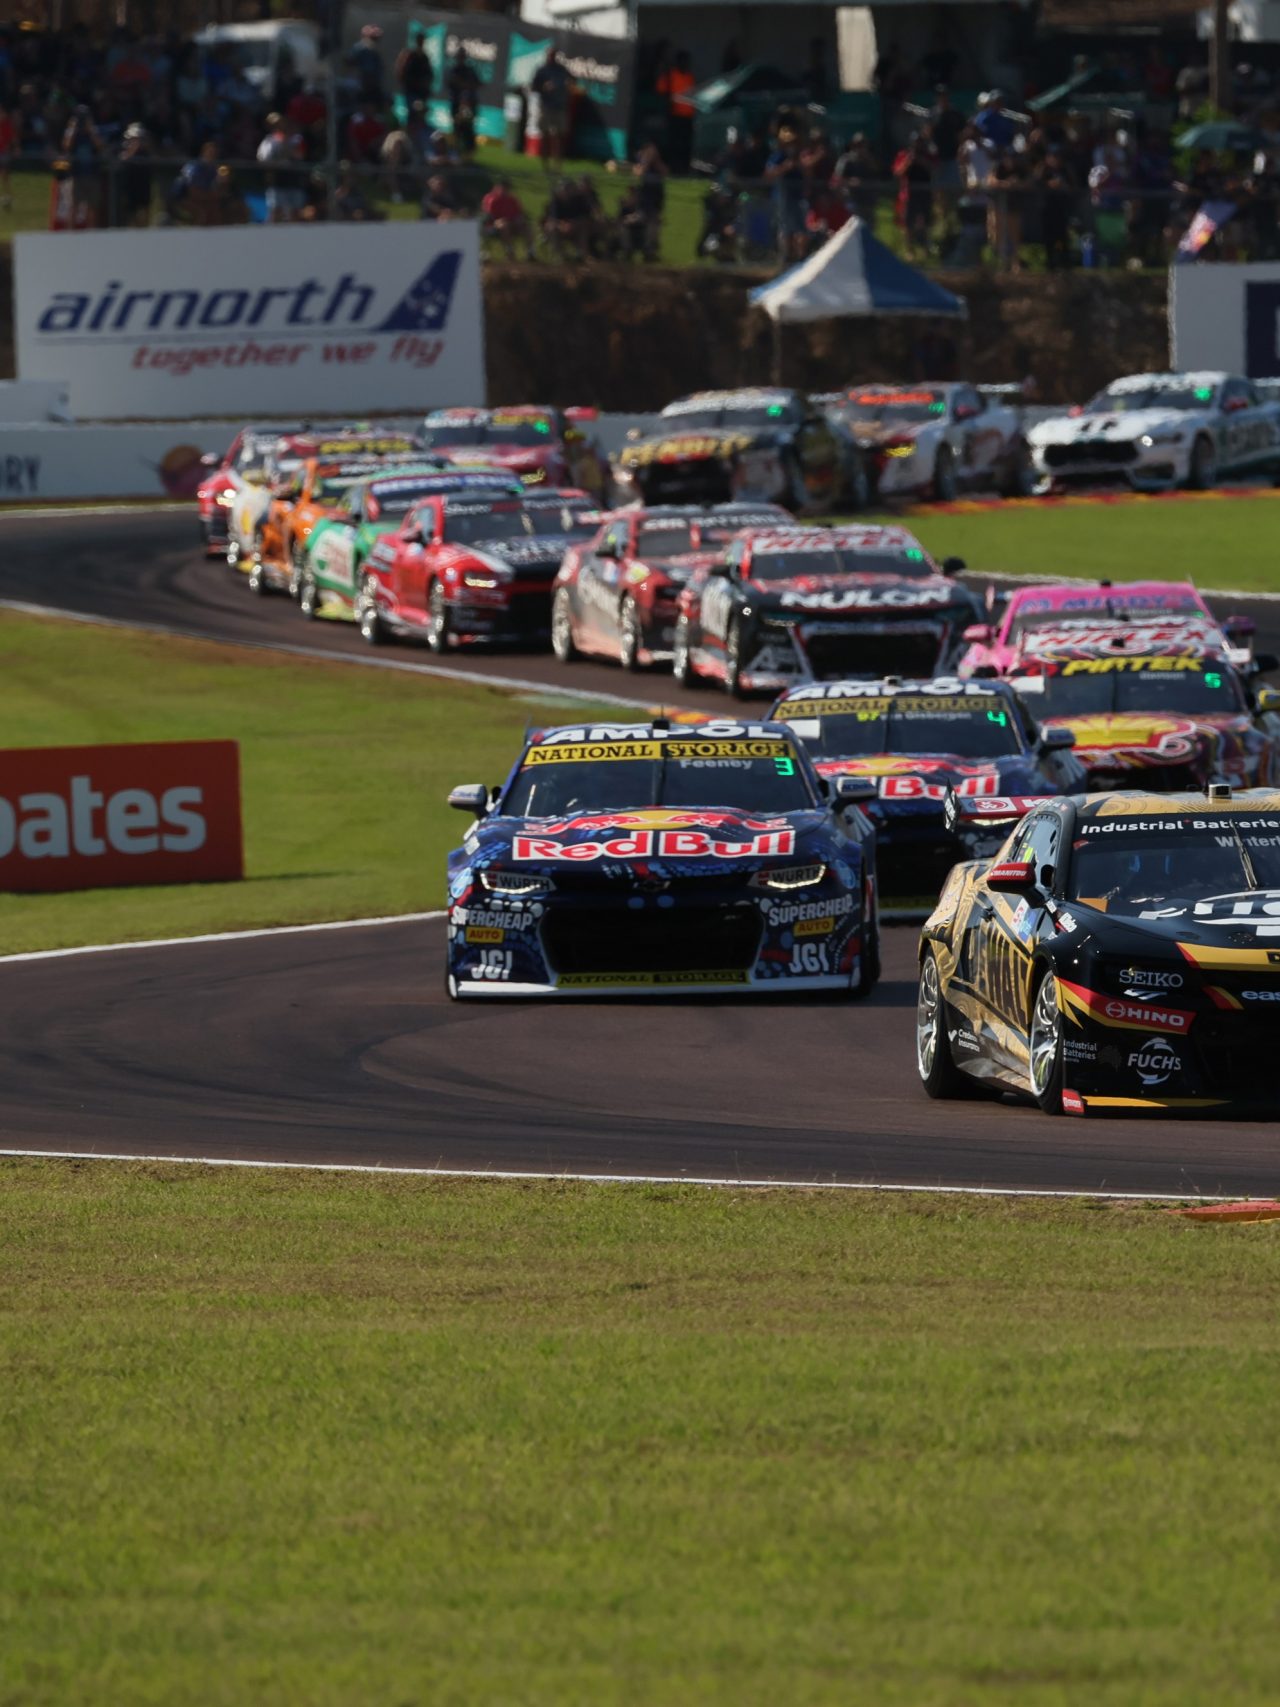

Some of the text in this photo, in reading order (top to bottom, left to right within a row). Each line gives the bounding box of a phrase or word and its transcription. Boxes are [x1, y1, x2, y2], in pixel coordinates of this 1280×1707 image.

[37, 270, 375, 333] airnorth
[131, 333, 444, 375] together we fly
[780, 586, 951, 610] NULON
[1062, 656, 1203, 676] PIRTEK
[779, 697, 999, 716] NATIONAL STORAGE
[986, 710, 1007, 727] 4
[541, 720, 783, 745] AMPOL
[531, 742, 786, 763] NATIONAL STORAGE
[680, 758, 753, 771] Feeney
[774, 757, 795, 776] 3
[1081, 820, 1184, 835] Industrial
[513, 829, 796, 861] Red Bull
[451, 905, 533, 931] SUPERCHEAP
[768, 893, 854, 927] SUPERCHEAP
[469, 929, 501, 940] AUTO
[797, 921, 831, 932] AUTO
[559, 971, 744, 984] NATIONAL STORAGE
[1119, 969, 1184, 988] SEIKO
[1128, 1007, 1185, 1027] HINO
[1063, 1039, 1097, 1051] Industrial
[1063, 1049, 1096, 1060] Batteries
[1127, 1053, 1182, 1071] FUCHS
